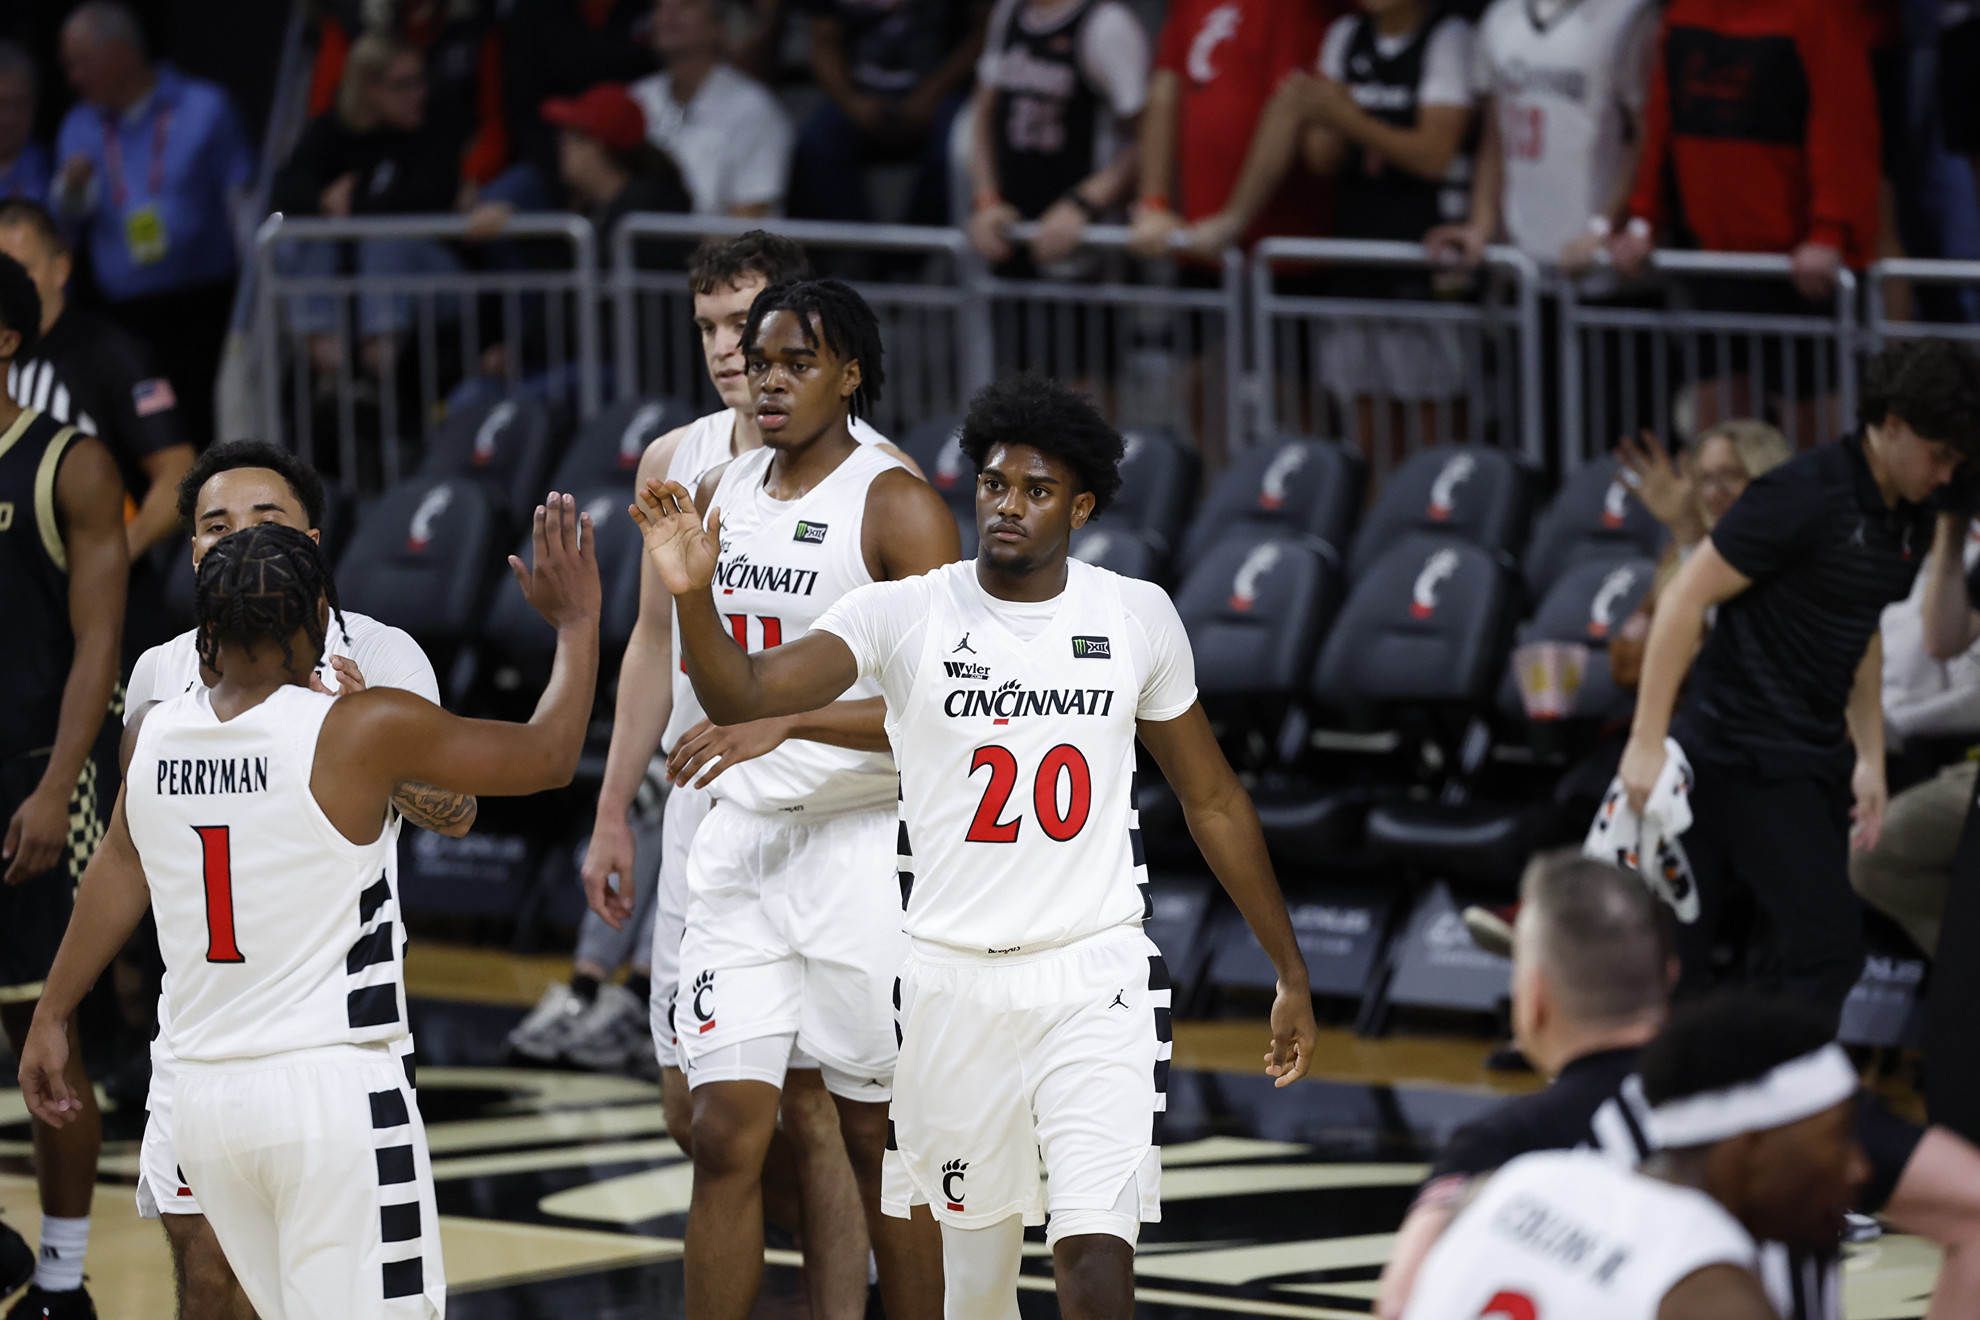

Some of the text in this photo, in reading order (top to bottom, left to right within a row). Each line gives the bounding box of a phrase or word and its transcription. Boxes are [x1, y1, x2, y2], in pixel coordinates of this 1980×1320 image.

[712, 556, 819, 596] NCINNATI
[943, 661, 991, 679] Wyler
[944, 680, 1115, 718] CINCINNATI
[157, 757, 268, 795] PERRYMAN
[965, 743, 1092, 843] 20
[189, 825, 246, 964] 1
